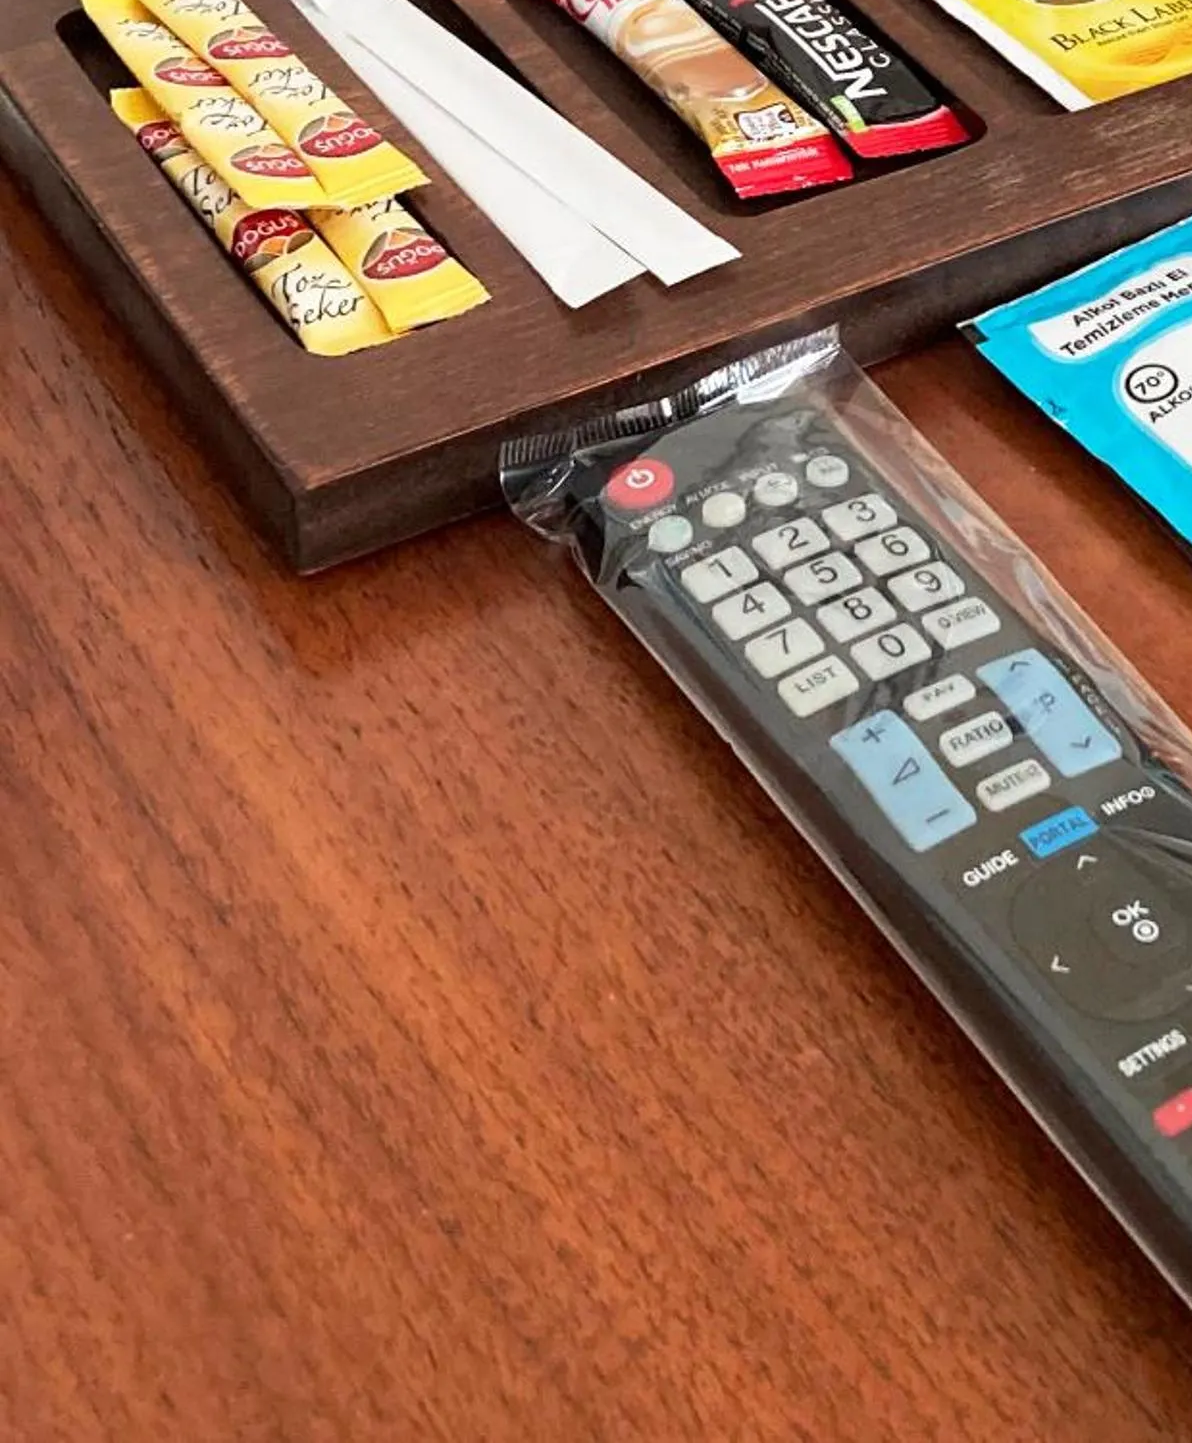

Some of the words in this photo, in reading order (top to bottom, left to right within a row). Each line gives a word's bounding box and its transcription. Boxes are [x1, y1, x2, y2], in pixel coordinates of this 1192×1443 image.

[1050, 15, 1135, 51] BLACK
[1058, 297, 1161, 357] Temizleme
[1071, 298, 1122, 328] Alkol
[1134, 370, 1166, 397] 70°
[708, 557, 734, 579] 1
[779, 525, 810, 551] 2
[848, 500, 877, 523] 3
[741, 594, 766, 616] 4
[810, 560, 838, 585] 5
[881, 533, 910, 557] 6
[764, 628, 792, 655] 7
[843, 597, 873, 621] 8
[913, 570, 942, 594] 9
[796, 665, 839, 693] LIST
[877, 632, 906, 658] 0
[950, 718, 1005, 752] RATIO
[963, 848, 1019, 887] GUIDE
[1029, 814, 1090, 850] PORTAL
[1101, 791, 1142, 816] INFO
[1111, 900, 1149, 926] OK
[1117, 1027, 1188, 1078] SETTINGS
